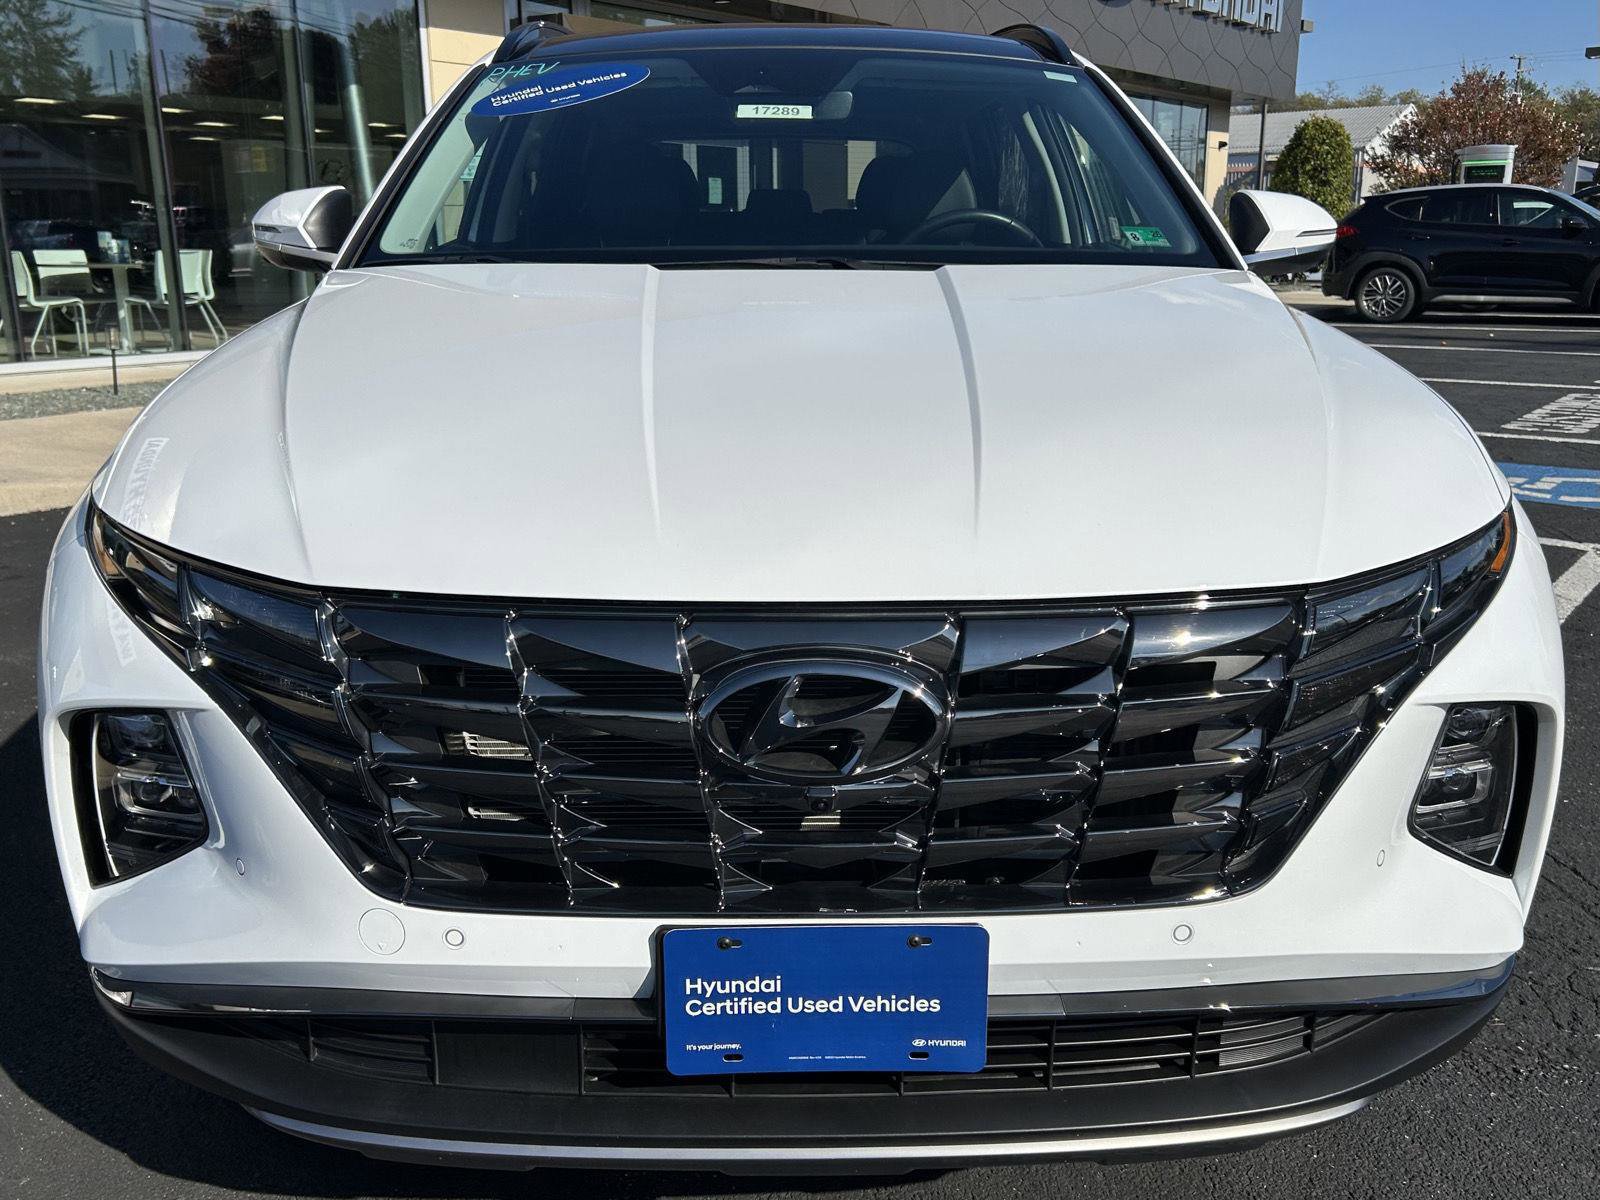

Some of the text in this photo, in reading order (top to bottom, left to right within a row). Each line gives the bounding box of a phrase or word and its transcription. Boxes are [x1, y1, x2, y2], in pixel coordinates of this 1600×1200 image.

[488, 61, 561, 82] PHEV
[491, 85, 542, 102] Hyundai
[492, 72, 628, 107] Certified Used Vehicles
[752, 106, 800, 116] 17289
[685, 975, 782, 998] Hyundai
[685, 994, 941, 1017] Certified Used Vehicles
[713, 1043, 742, 1051] journey.
[928, 1038, 967, 1047] HYUNDAI
